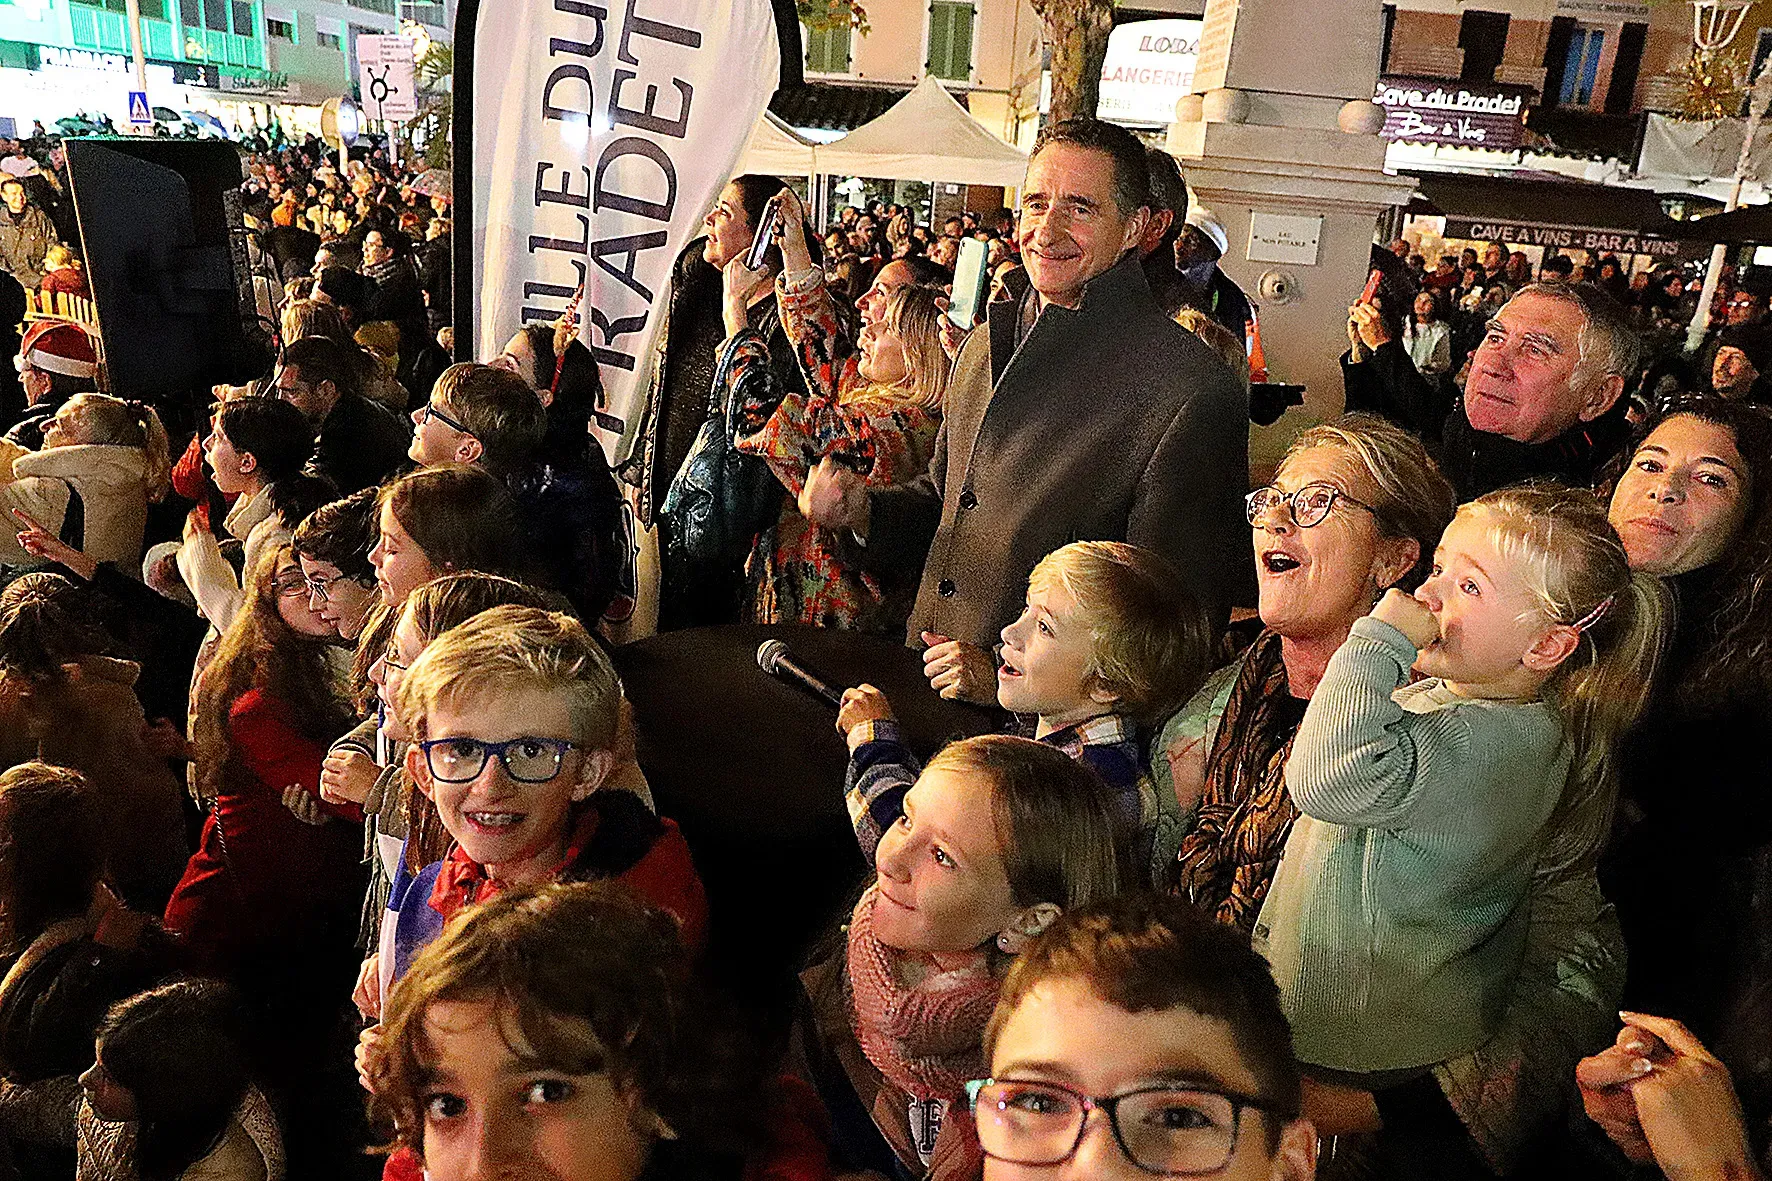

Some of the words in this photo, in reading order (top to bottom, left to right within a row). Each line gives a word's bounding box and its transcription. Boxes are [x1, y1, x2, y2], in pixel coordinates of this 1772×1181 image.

[1101, 65, 1194, 87] LANGERIE
[1426, 88, 1455, 108] du
[1457, 90, 1522, 115] Pradet
[1469, 224, 1514, 243] CAVE
[1533, 229, 1572, 247] VINS
[1584, 234, 1622, 250] BAR
[1640, 238, 1680, 255] VINS
